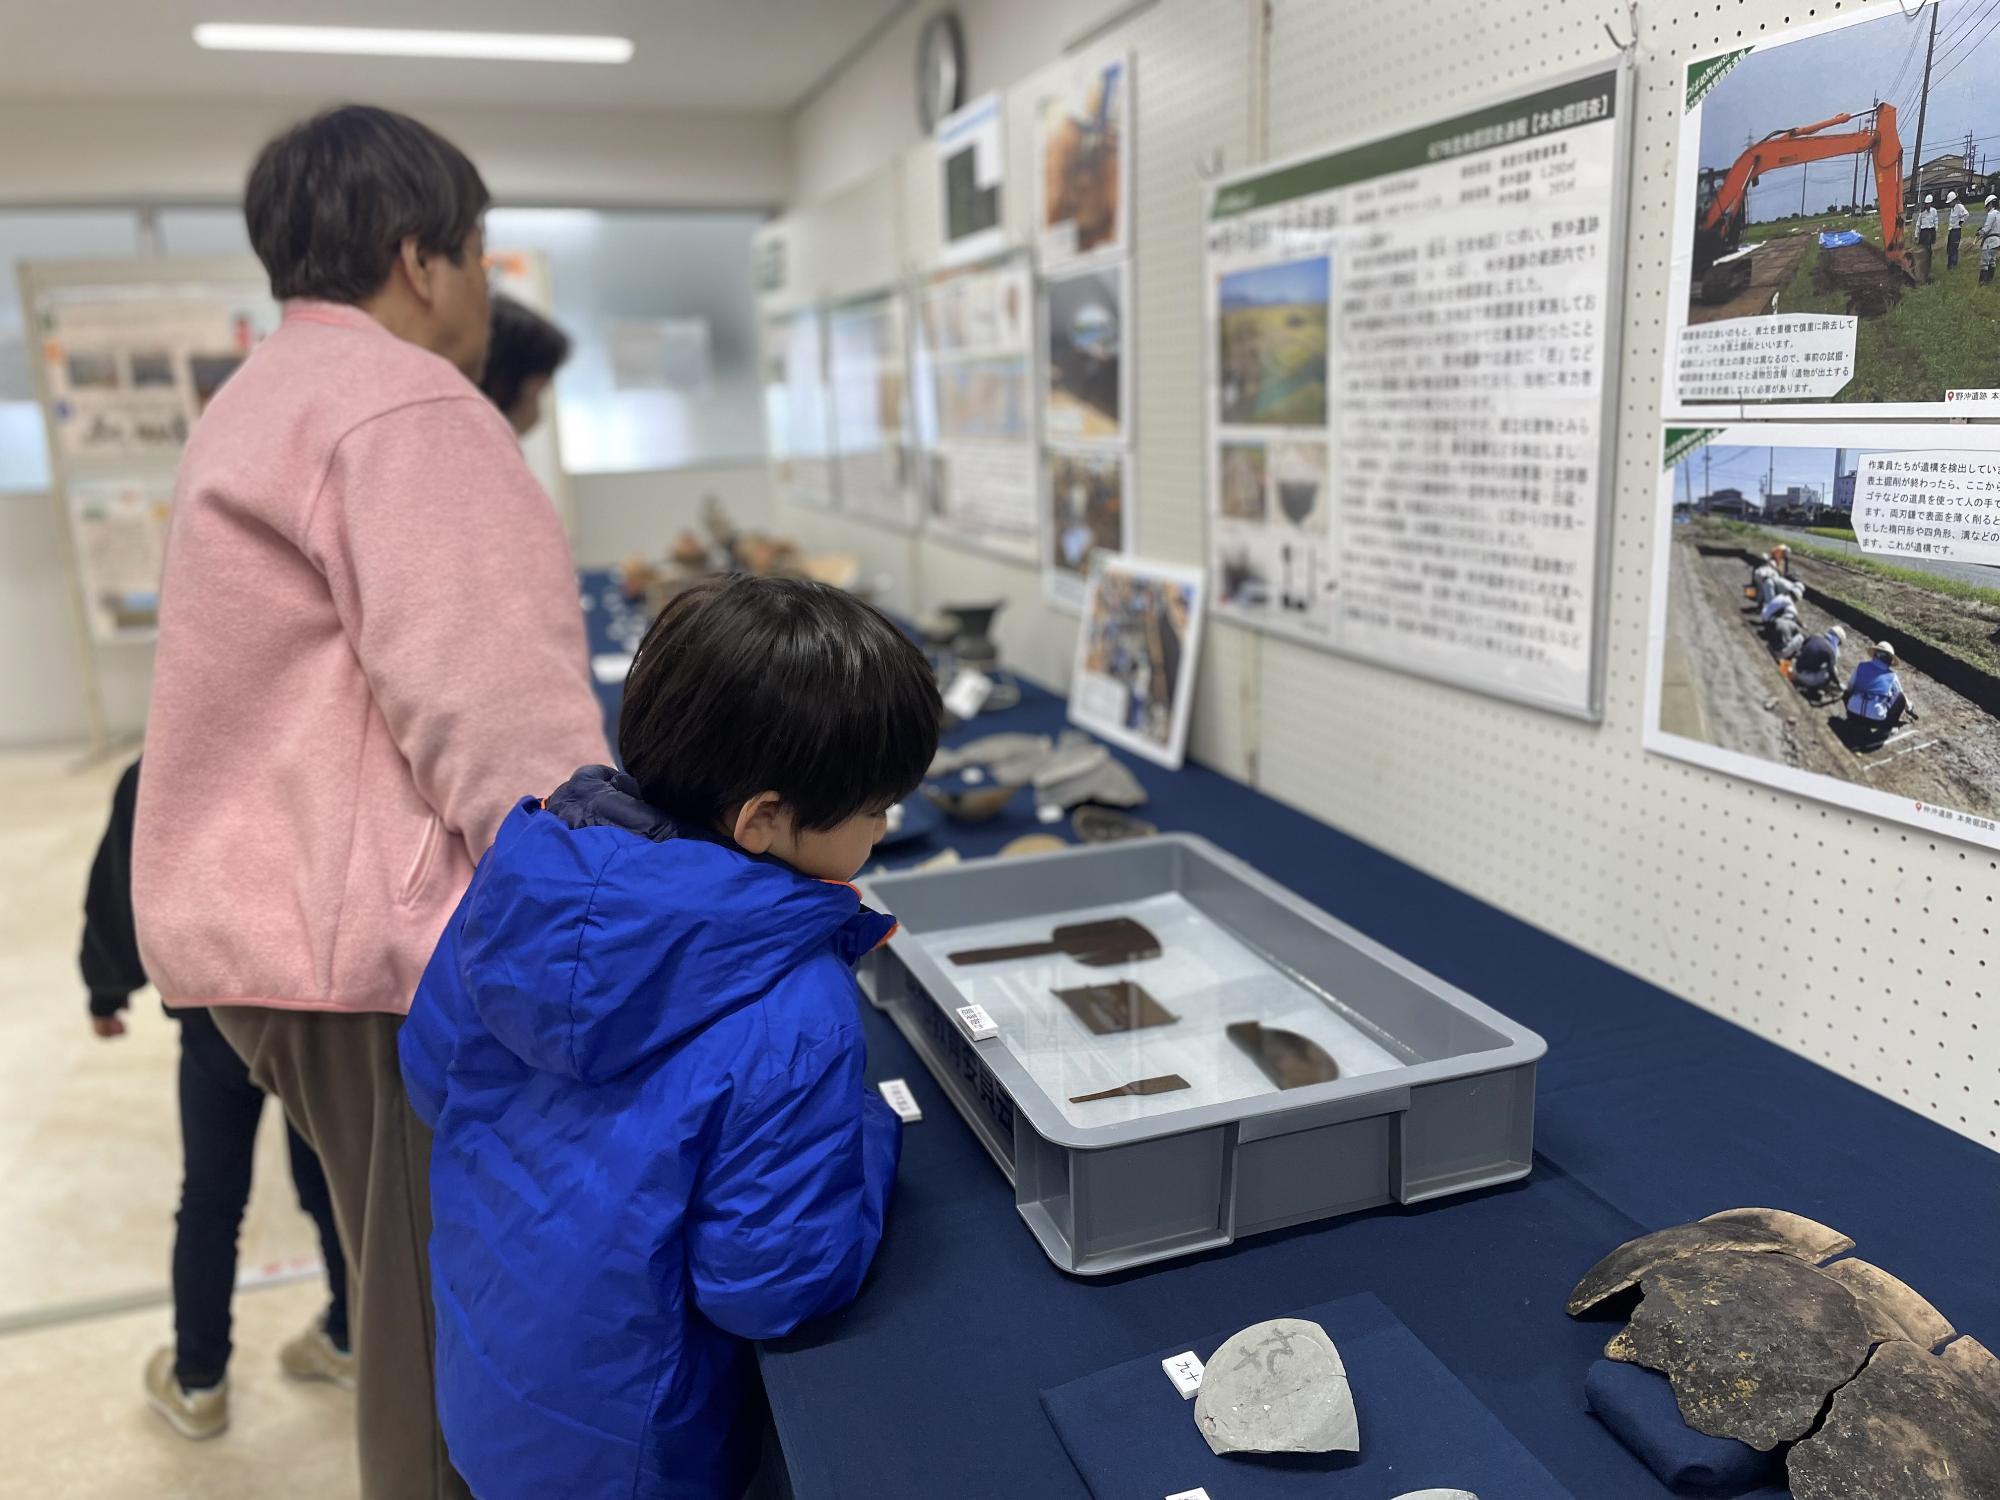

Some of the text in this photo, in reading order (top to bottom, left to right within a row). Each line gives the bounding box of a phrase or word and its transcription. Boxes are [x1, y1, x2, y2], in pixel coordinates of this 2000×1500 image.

[1862, 538, 1954, 555] ます。これが遺構です。
[1176, 1361, 1199, 1382] 九十
